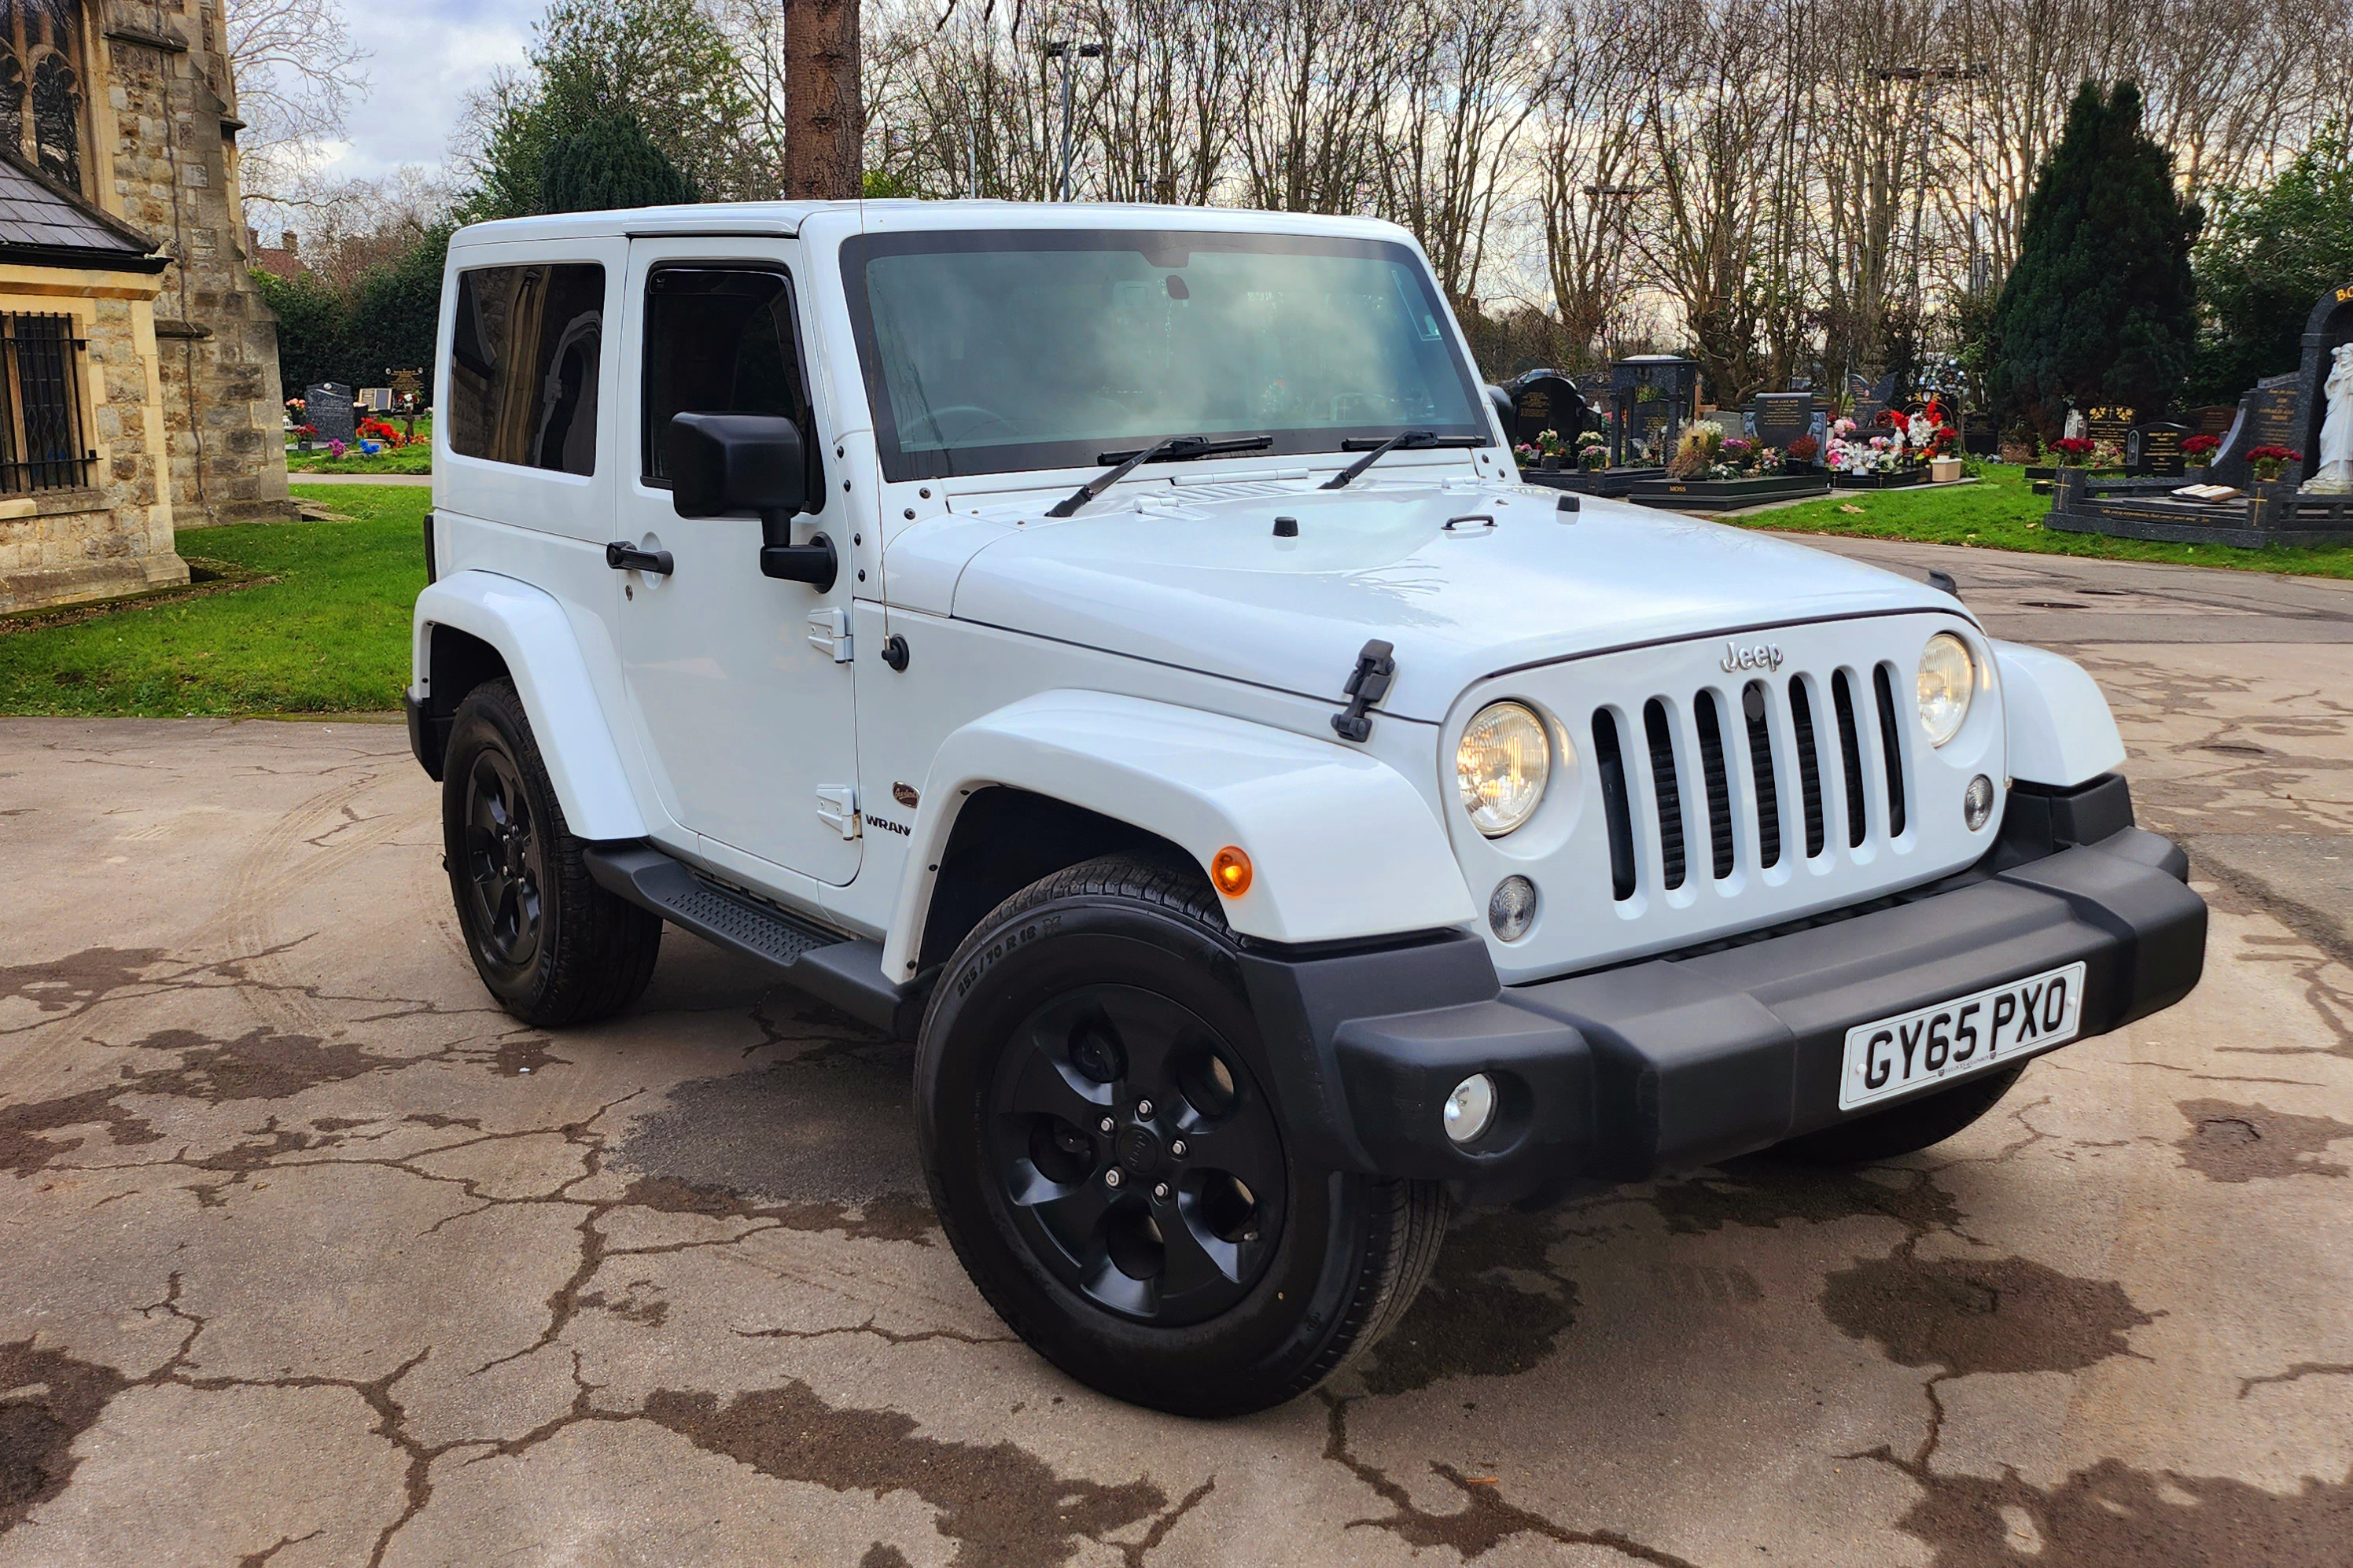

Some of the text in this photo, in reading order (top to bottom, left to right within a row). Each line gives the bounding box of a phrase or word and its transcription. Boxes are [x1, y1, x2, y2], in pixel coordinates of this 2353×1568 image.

[1720, 642, 1784, 673] Jeep
[1864, 976, 2067, 1090] GY65 PXO
